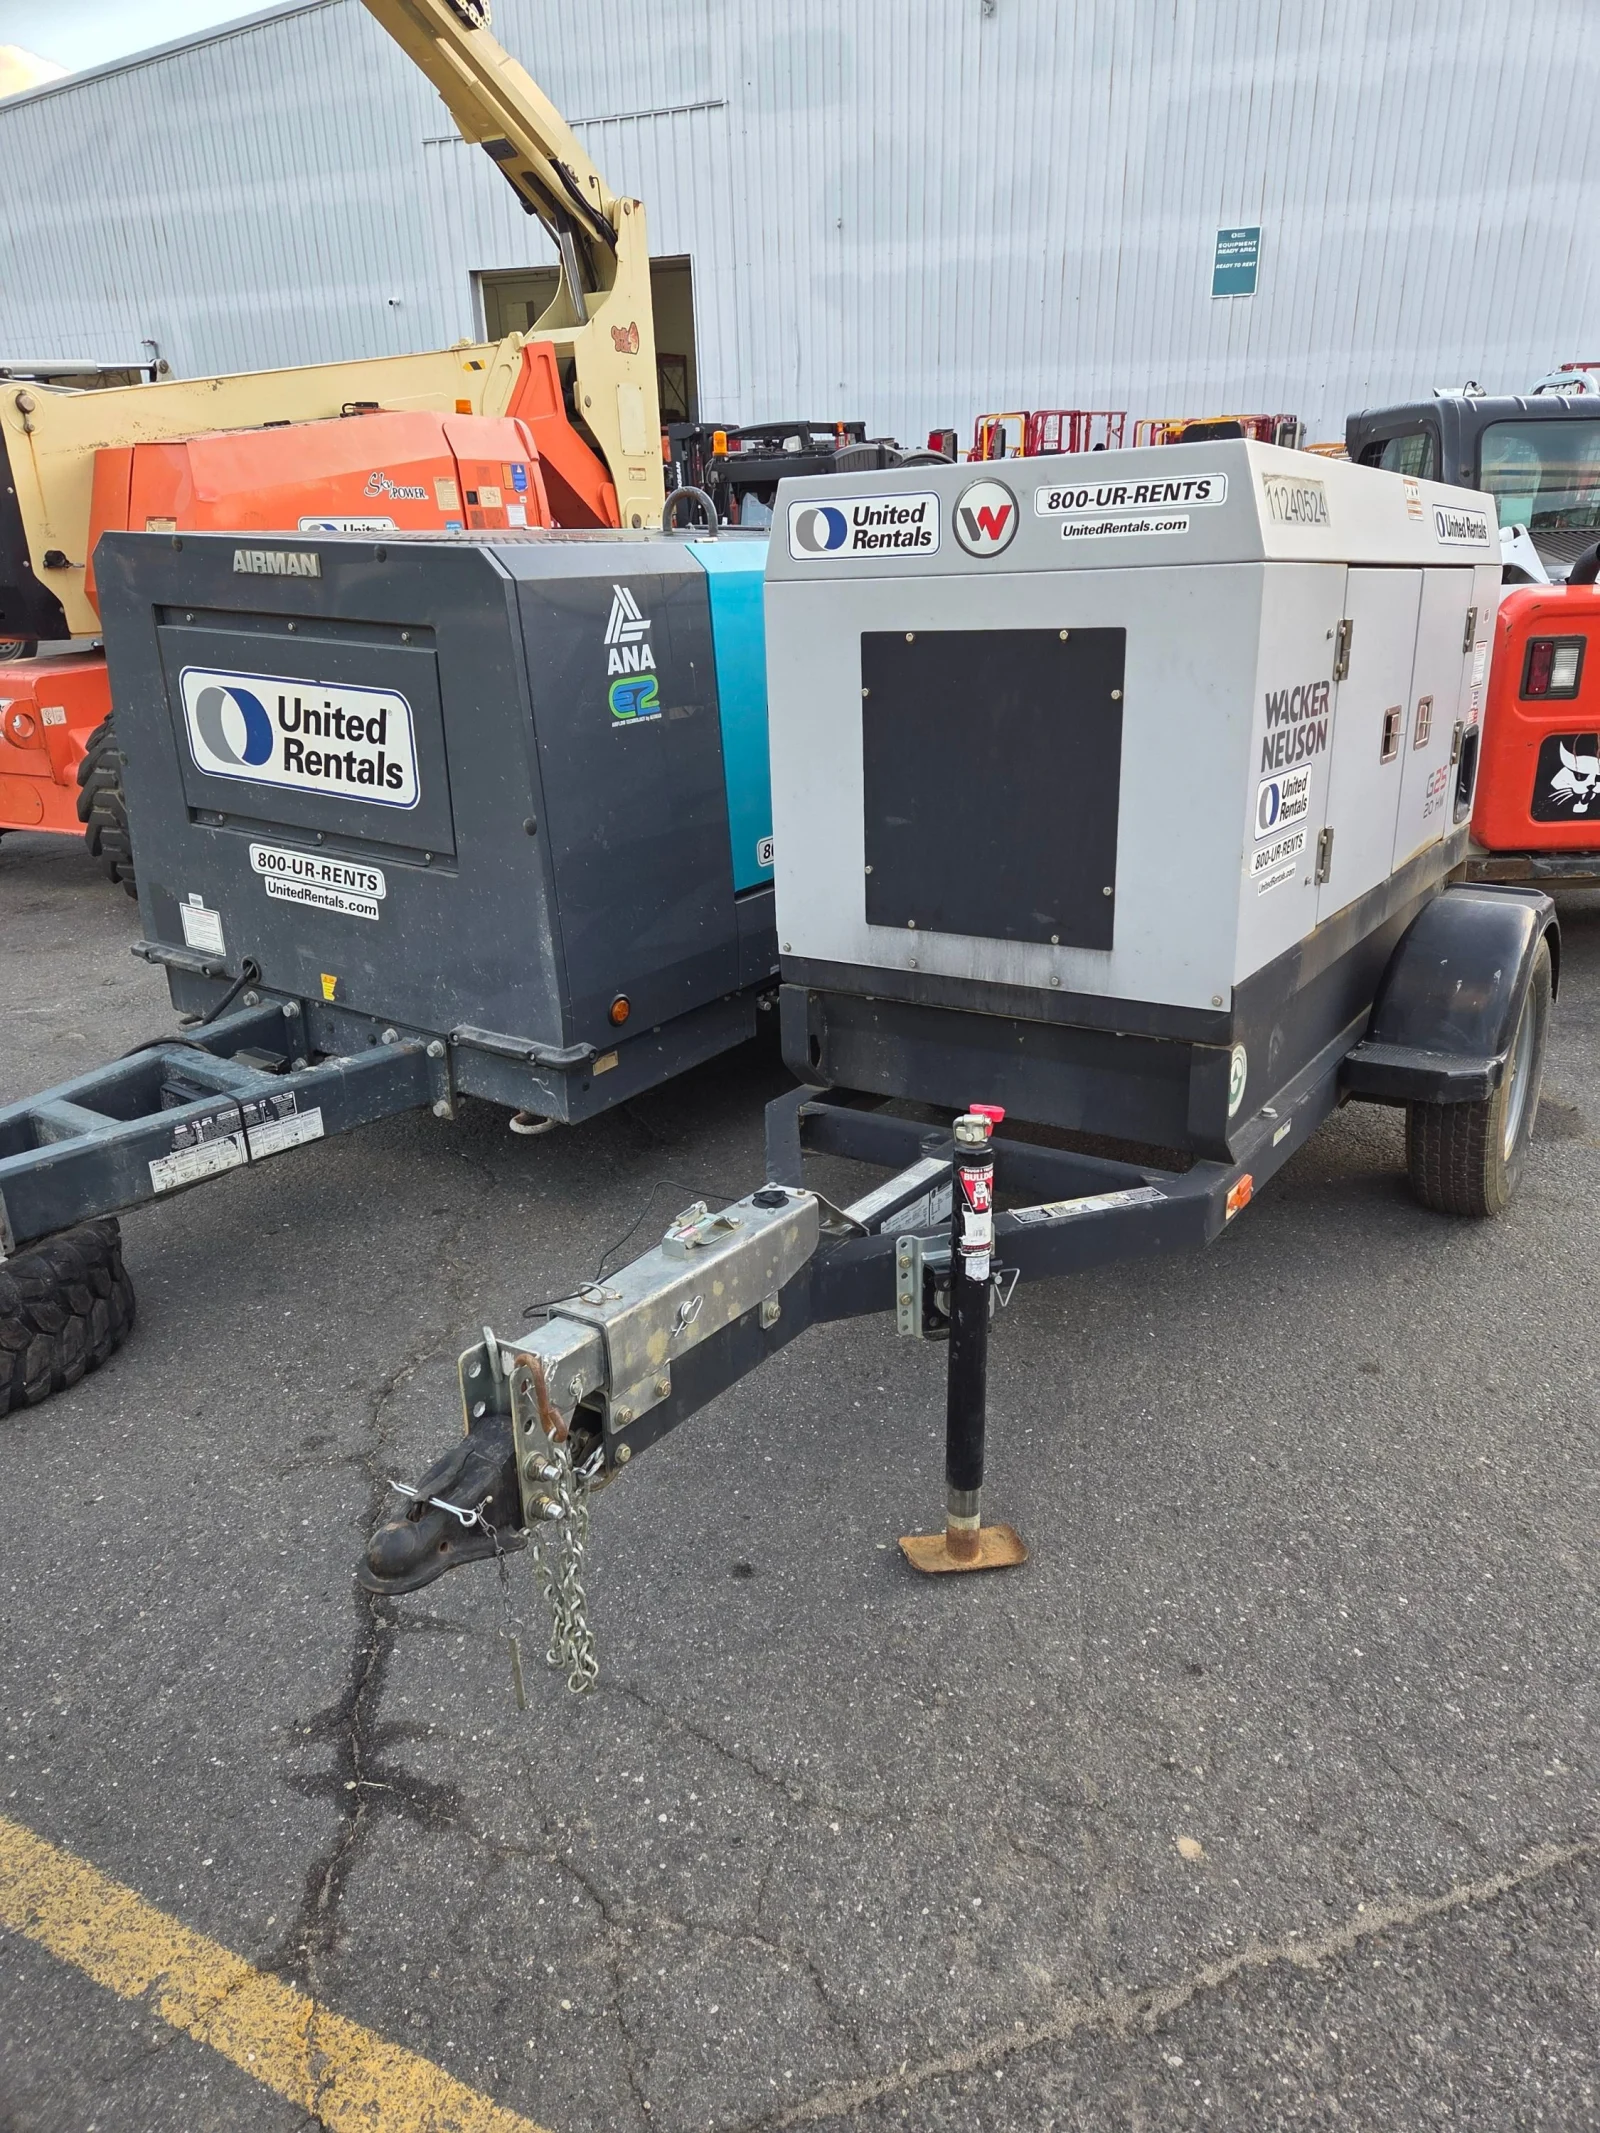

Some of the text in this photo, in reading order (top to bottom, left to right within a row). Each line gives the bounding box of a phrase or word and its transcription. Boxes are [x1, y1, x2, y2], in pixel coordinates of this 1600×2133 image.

[1218, 240, 1257, 249] EQUIPMENT
[393, 487, 426, 499] POWER
[1048, 479, 1212, 510] 800-UR-RENTS
[1266, 485, 1327, 523] 11240524
[852, 501, 927, 527] United
[1445, 513, 1488, 540] United Rentals
[852, 525, 932, 550] Rentals
[1063, 519, 1187, 538] UnitedRentals.com
[233, 550, 321, 577] AIRMAN
[607, 644, 656, 676] ANA
[1265, 680, 1330, 730] WACKER
[278, 695, 387, 745] United
[1261, 719, 1328, 773] NEUSON
[284, 737, 403, 790] Rentals
[1281, 773, 1308, 801] United
[1279, 796, 1307, 822] Rentals
[763, 843, 774, 860] 8
[1255, 832, 1303, 871] 800-UR-RENTS
[258, 851, 378, 891] 800-UR-RENTS
[268, 881, 377, 916] UnitedRentals.com
[963, 1170, 994, 1182] BULLDO
